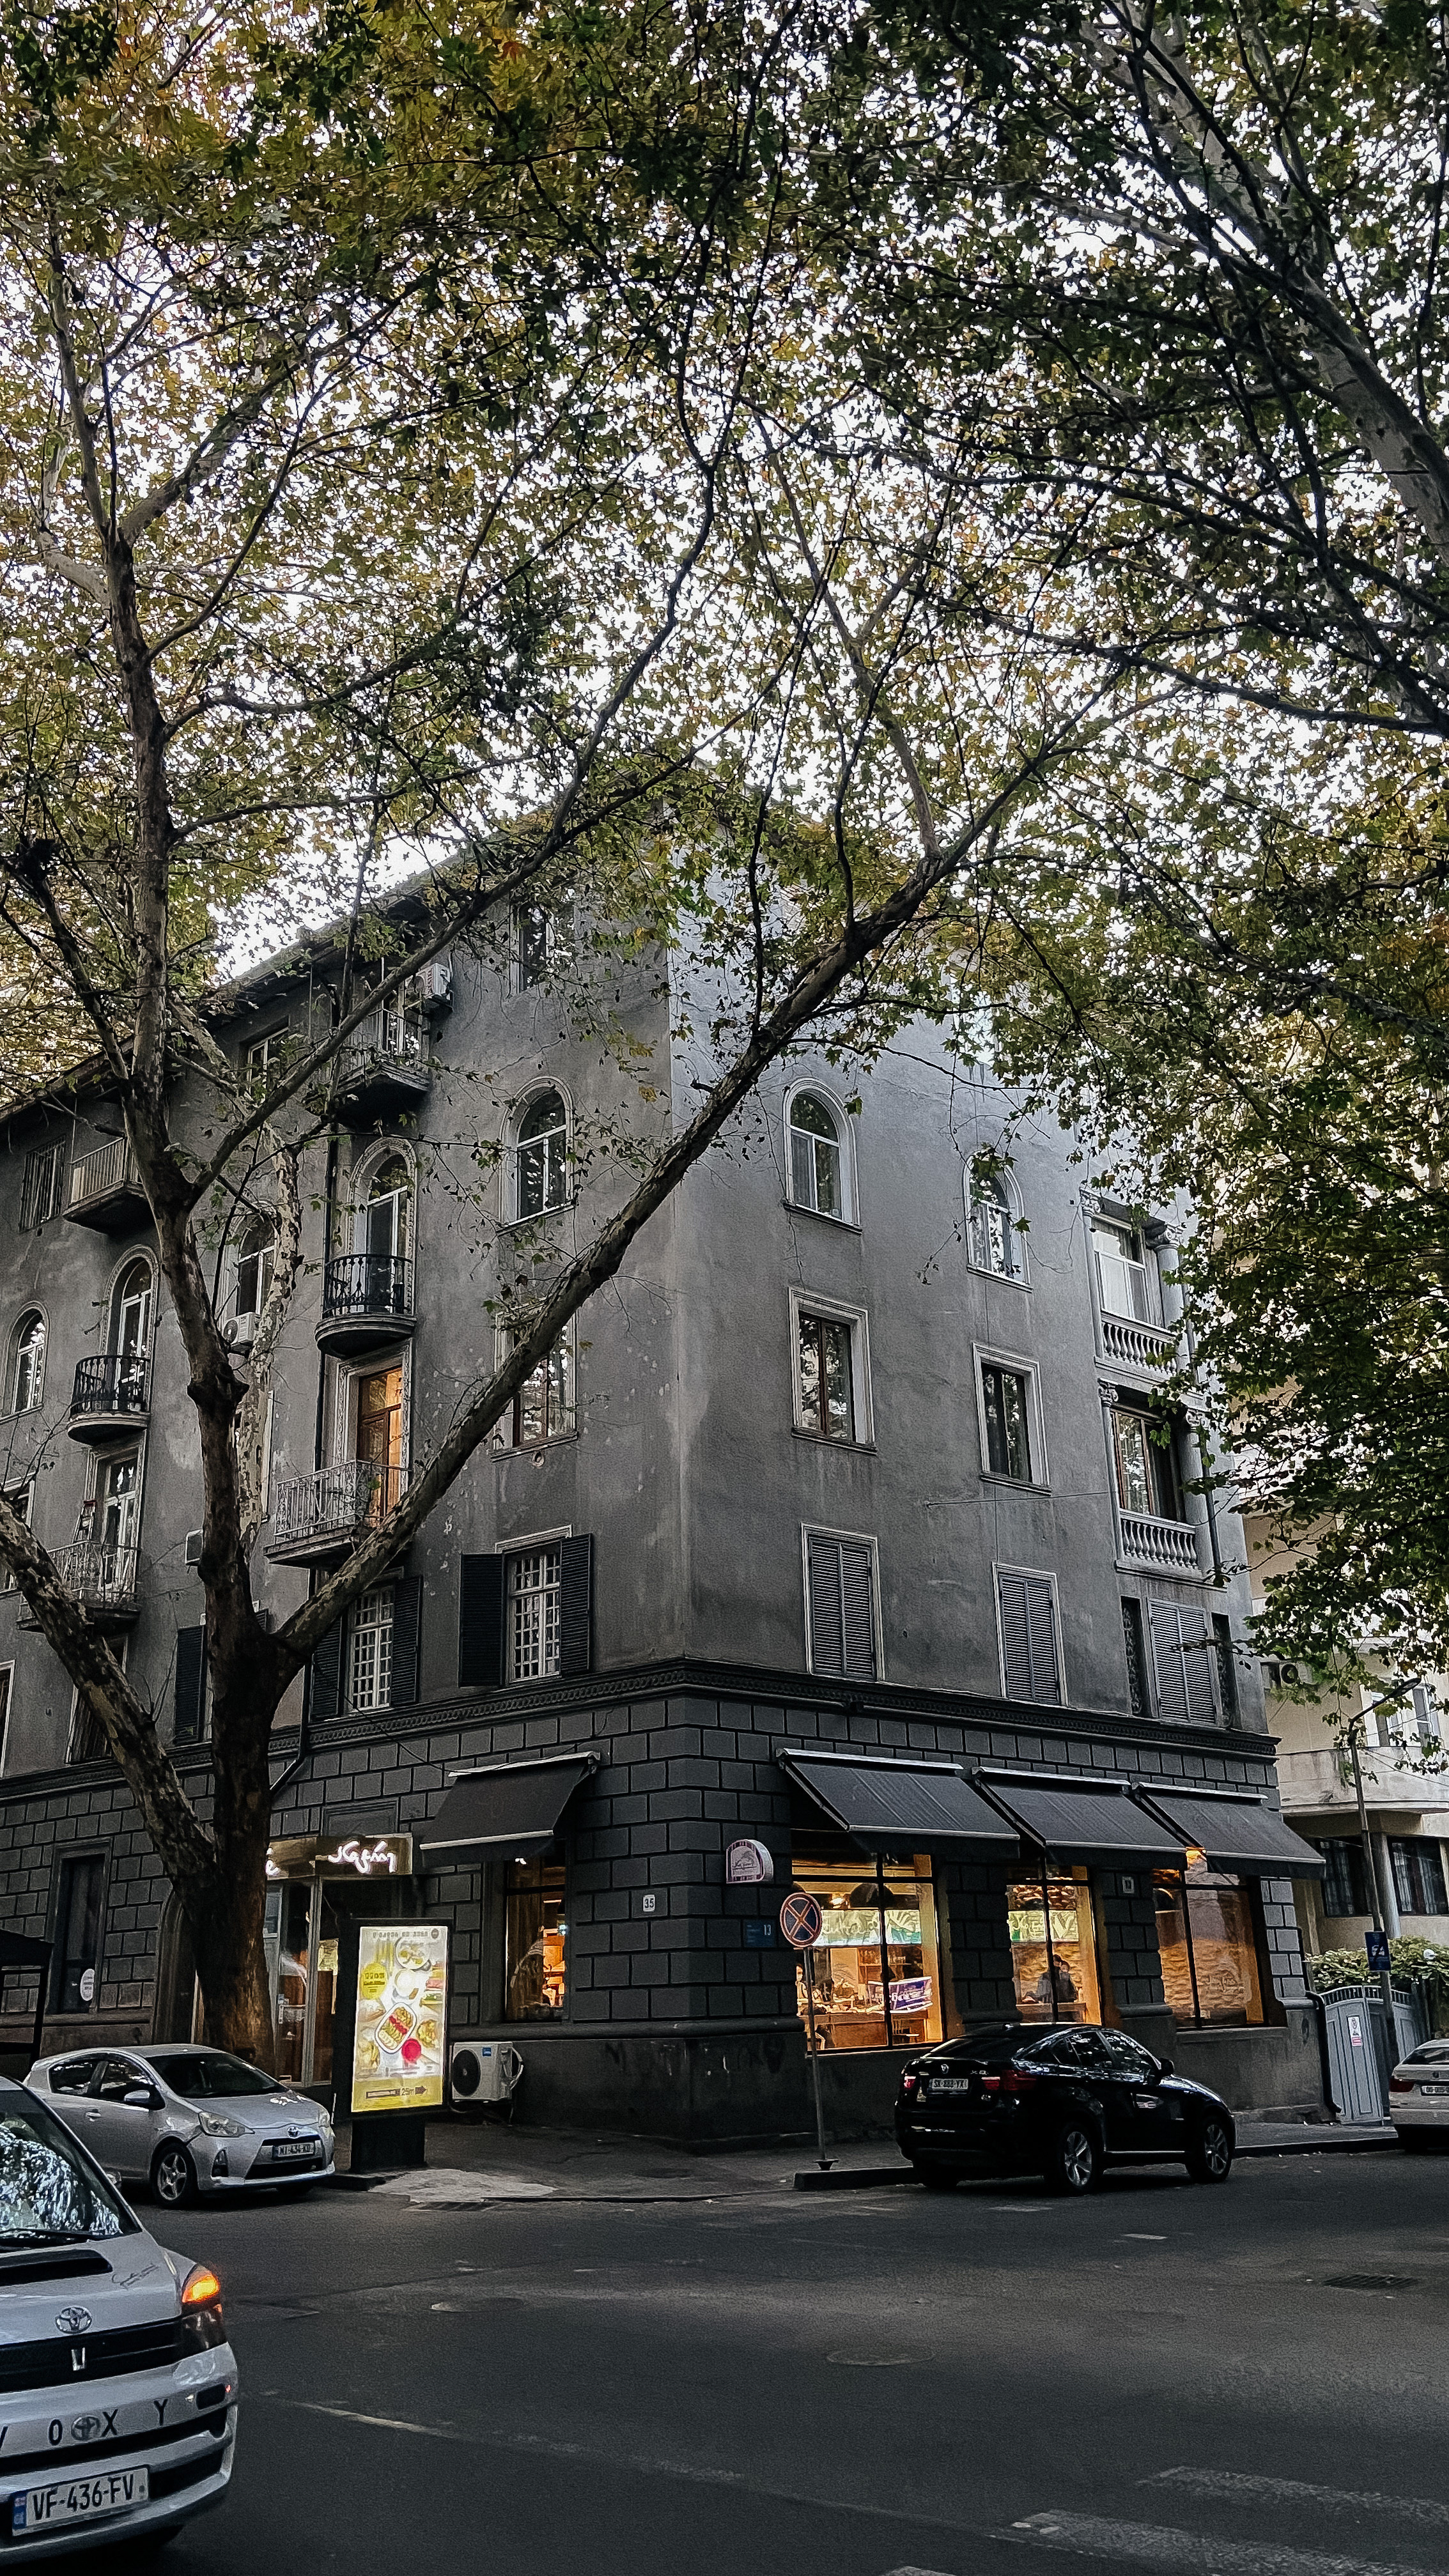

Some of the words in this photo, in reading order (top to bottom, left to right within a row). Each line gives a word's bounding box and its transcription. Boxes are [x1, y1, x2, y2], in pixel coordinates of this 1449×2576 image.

[644, 1898, 654, 1909] 35
[763, 1924, 771, 1936] 13
[33, 2473, 134, 2521] VF-436-FV
